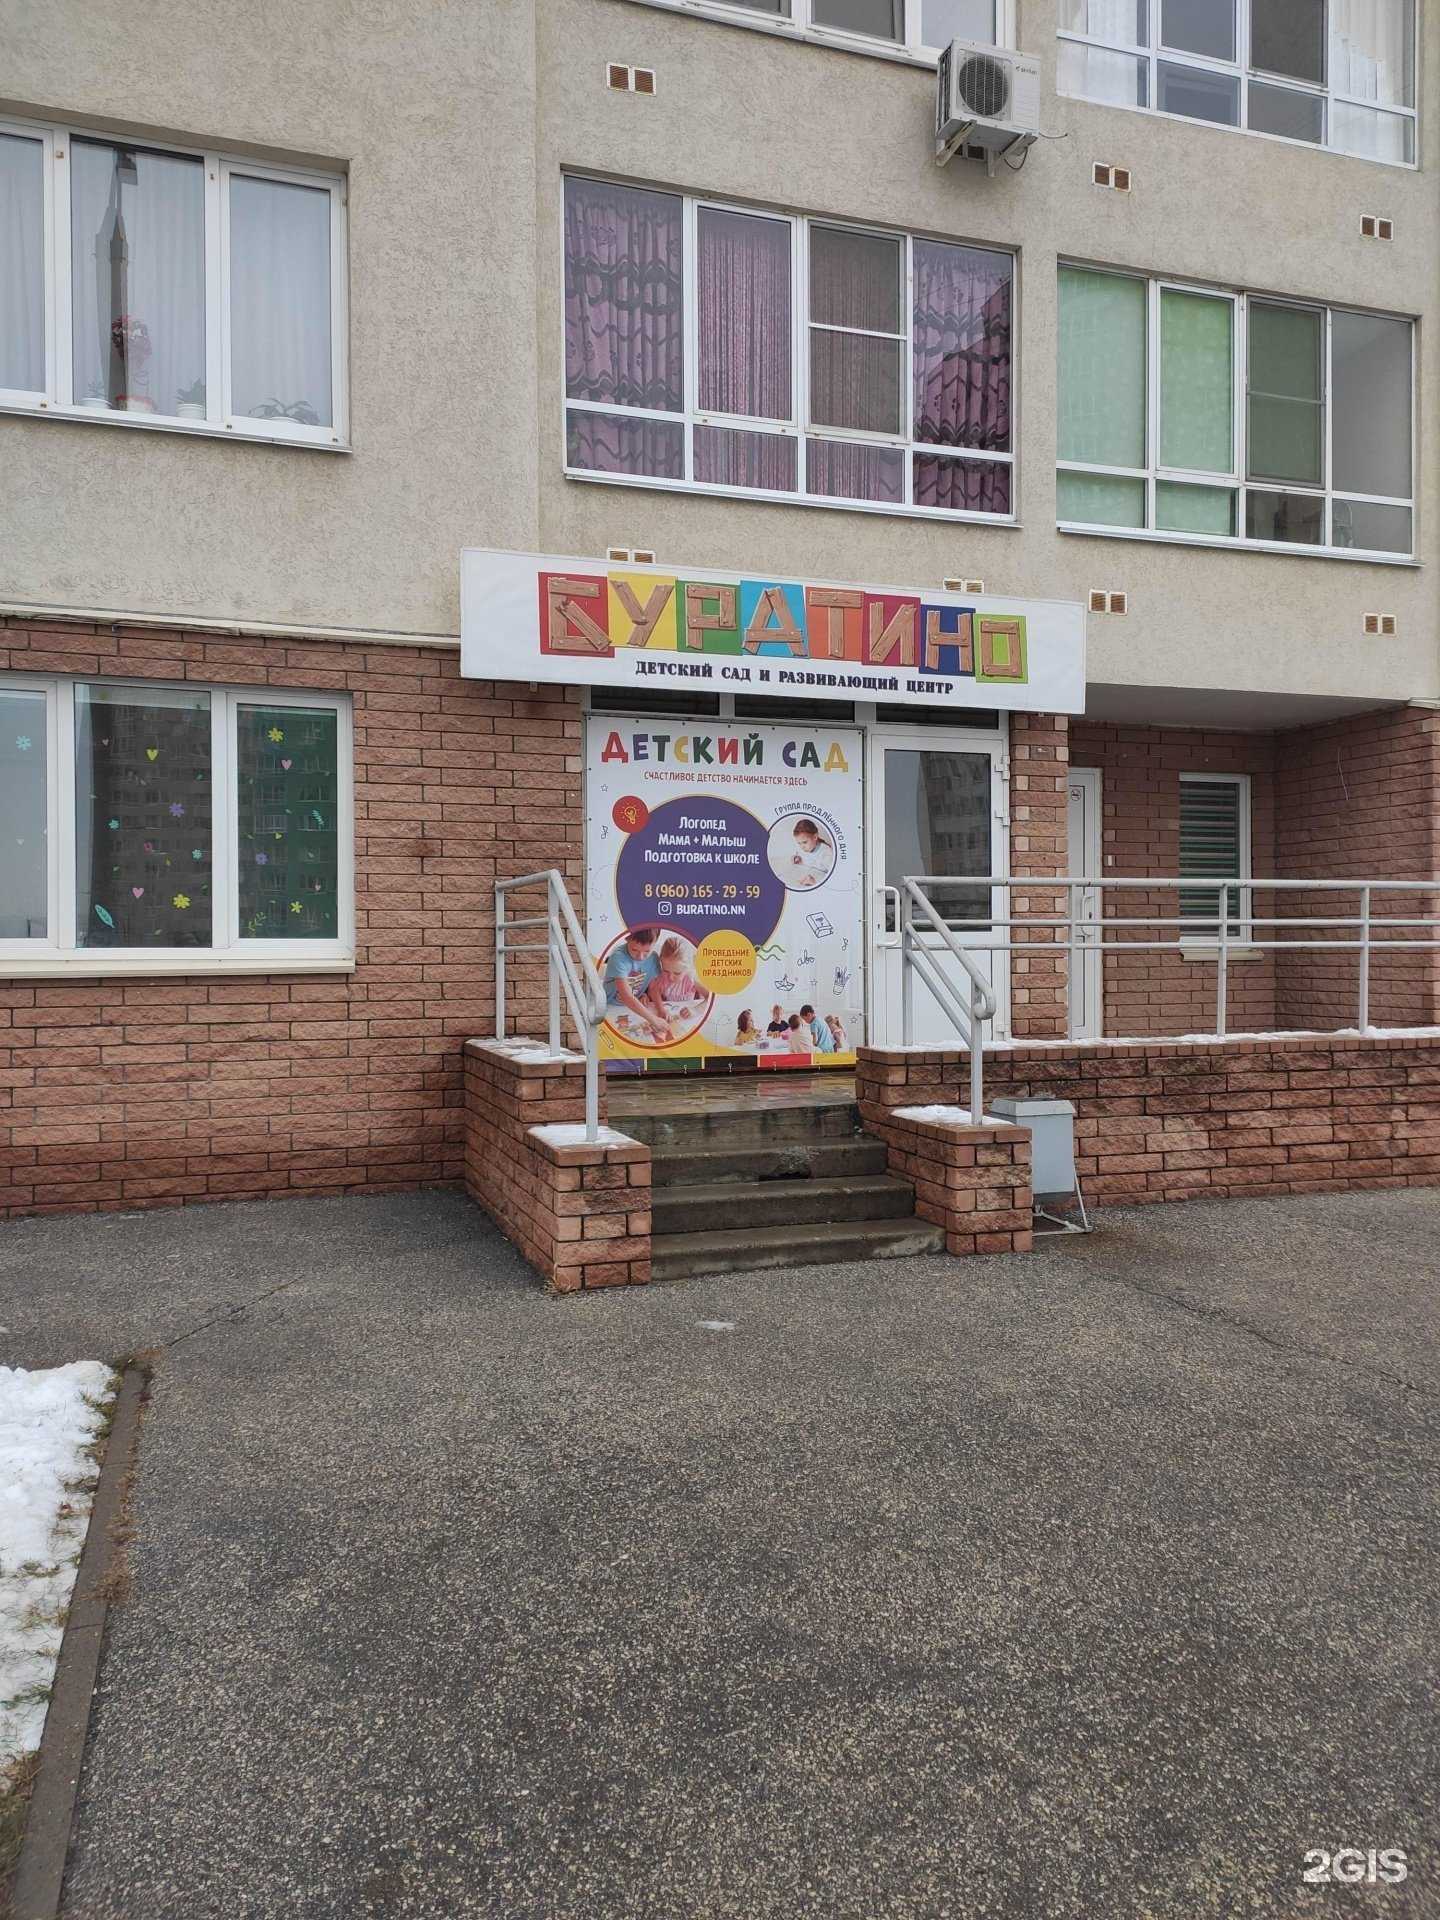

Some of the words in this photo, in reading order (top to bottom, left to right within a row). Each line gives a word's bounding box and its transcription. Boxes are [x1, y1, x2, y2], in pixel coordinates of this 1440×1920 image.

[547, 576, 1021, 678] БУРАТИНО
[635, 660, 713, 678] ДЕТСКИЙ
[721, 667, 751, 682] САД
[759, 670, 770, 682] И
[778, 671, 899, 692] РАЗВИВАЮЩИЙ
[906, 680, 953, 695] ЦЕНТР
[600, 731, 764, 766] ДЕТСКИЙ
[782, 741, 849, 773] САД
[644, 771, 695, 782] СЧАСТЛИВОЕ
[696, 773, 732, 783] ДЕТСТВО
[733, 775, 782, 785] НАЧИНАЕТСЯ
[783, 776, 808, 786] ЗДЕСЬ
[679, 816, 727, 831] ЛОГОПЕД
[774, 802, 801, 817] ГРУППА
[839, 842, 847, 860] ДНЯ
[658, 833, 691, 846] МАМА
[701, 834, 747, 847] МАЛЫШ
[644, 849, 713, 864] ПОДГОТОВКА
[714, 853, 722, 863] К
[723, 853, 760, 864] ШКОЛЕ
[644, 884, 653, 898] 8
[655, 884, 689, 898] (960)
[692, 885, 713, 898] 165
[676, 903, 746, 915] BURATINO.NN
[702, 948, 751, 957] ПРОВЕДЕНИЕ
[711, 959, 742, 967] ДЕТСКИХ
[702, 969, 752, 977] ПРАЗДНИКОВ
